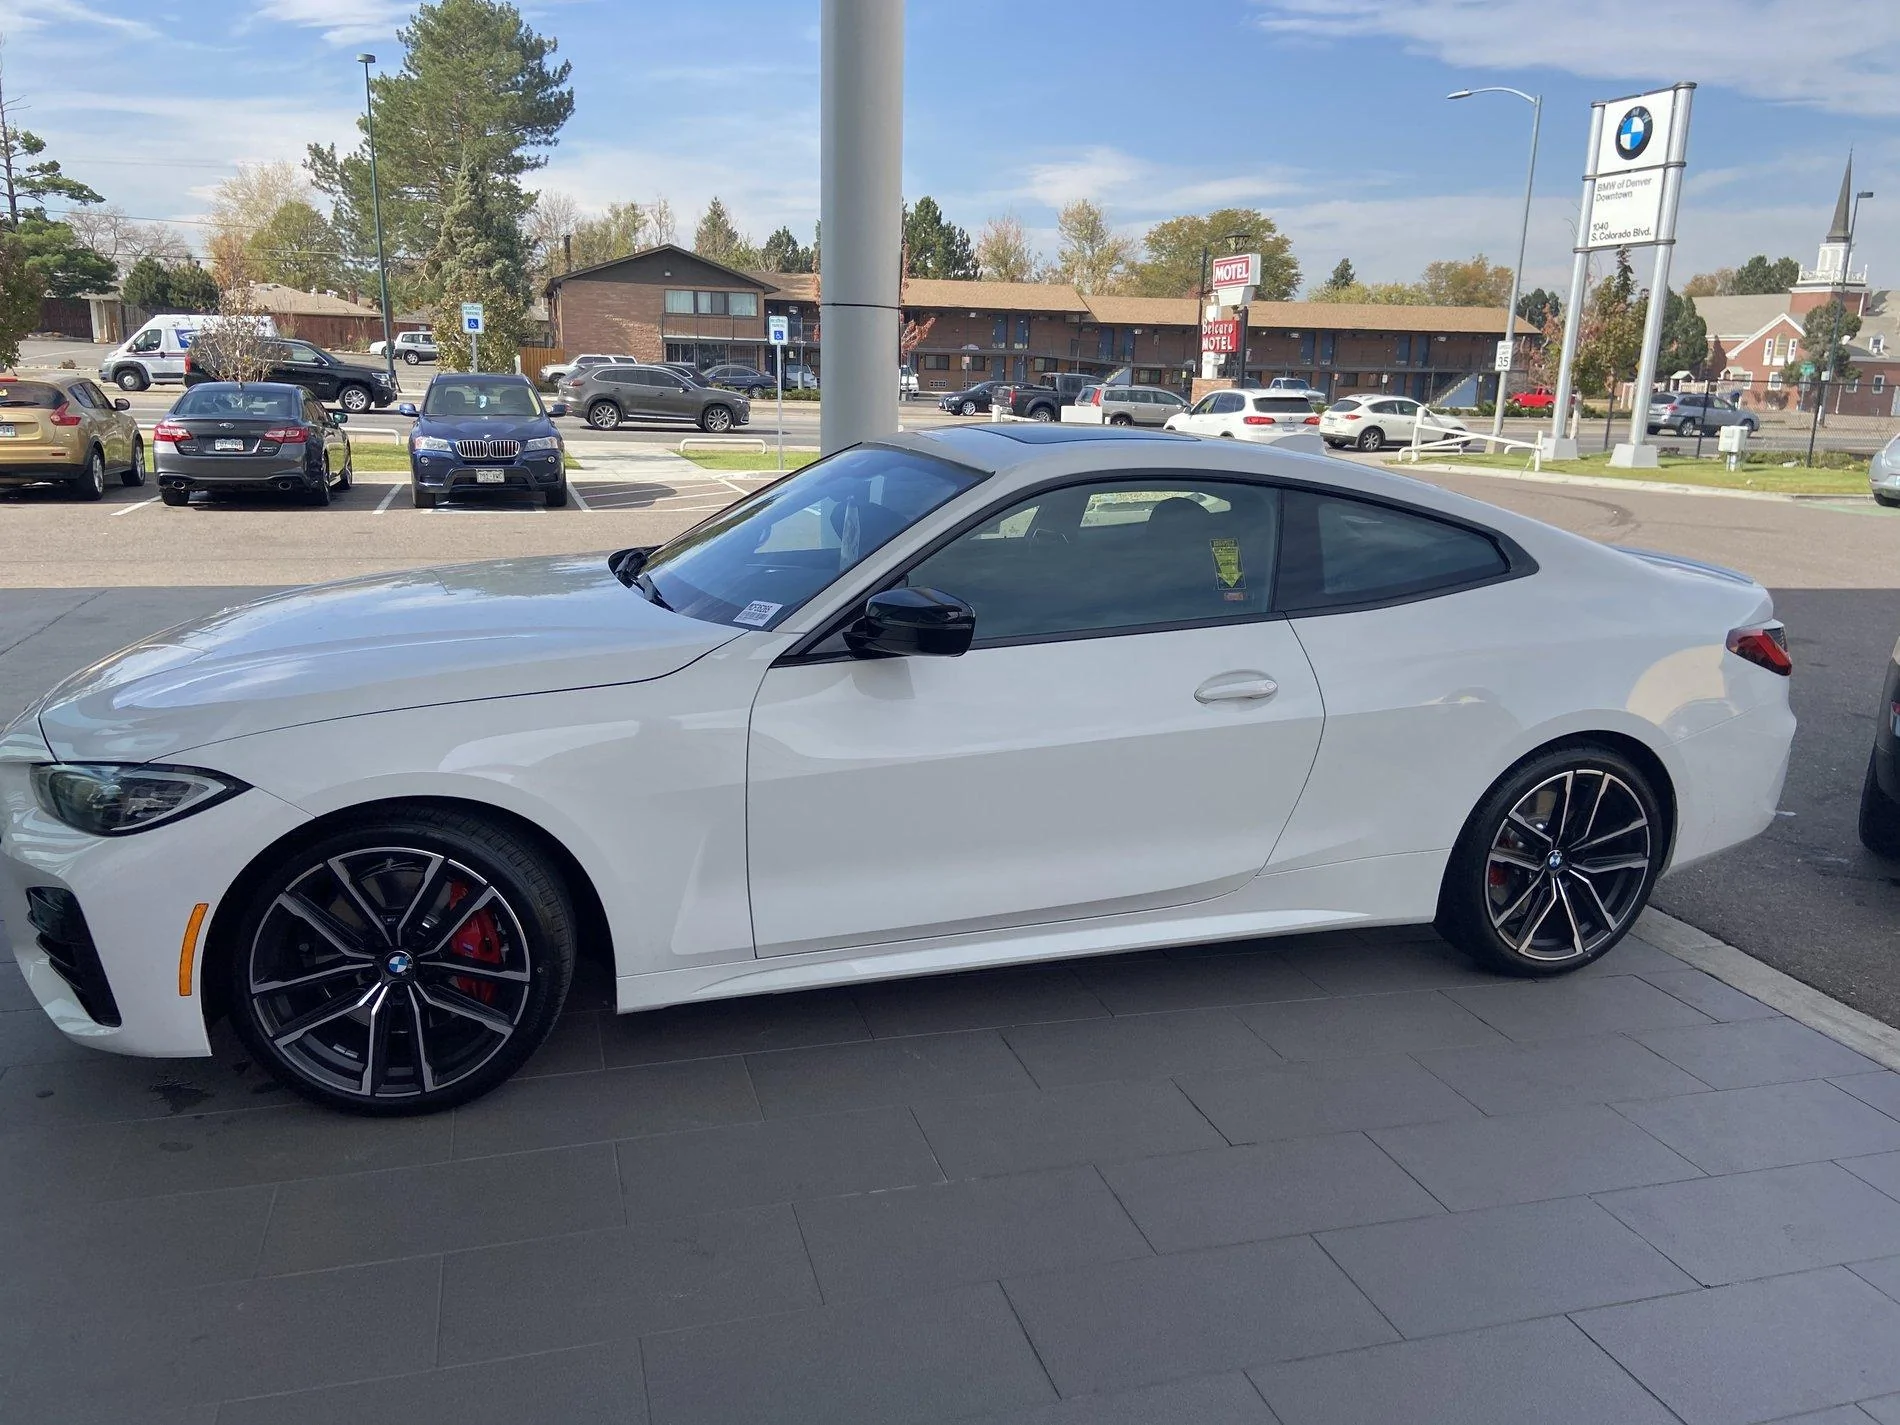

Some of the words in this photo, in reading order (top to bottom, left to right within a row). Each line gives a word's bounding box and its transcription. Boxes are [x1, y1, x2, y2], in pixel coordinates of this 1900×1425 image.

[1597, 181, 1617, 192] BMW
[1618, 179, 1626, 189] of
[1626, 177, 1652, 188] Denver
[1596, 190, 1633, 202] Downtown
[1592, 222, 1609, 231] 1040
[1591, 232, 1599, 242] S.
[1600, 229, 1631, 241] Colorado
[1632, 227, 1652, 238] Blvd.
[1215, 262, 1249, 282] MOTEL
[1202, 319, 1234, 335] Belcaro
[1202, 336, 1233, 351] MOTEL
[1497, 356, 1509, 367] 35
